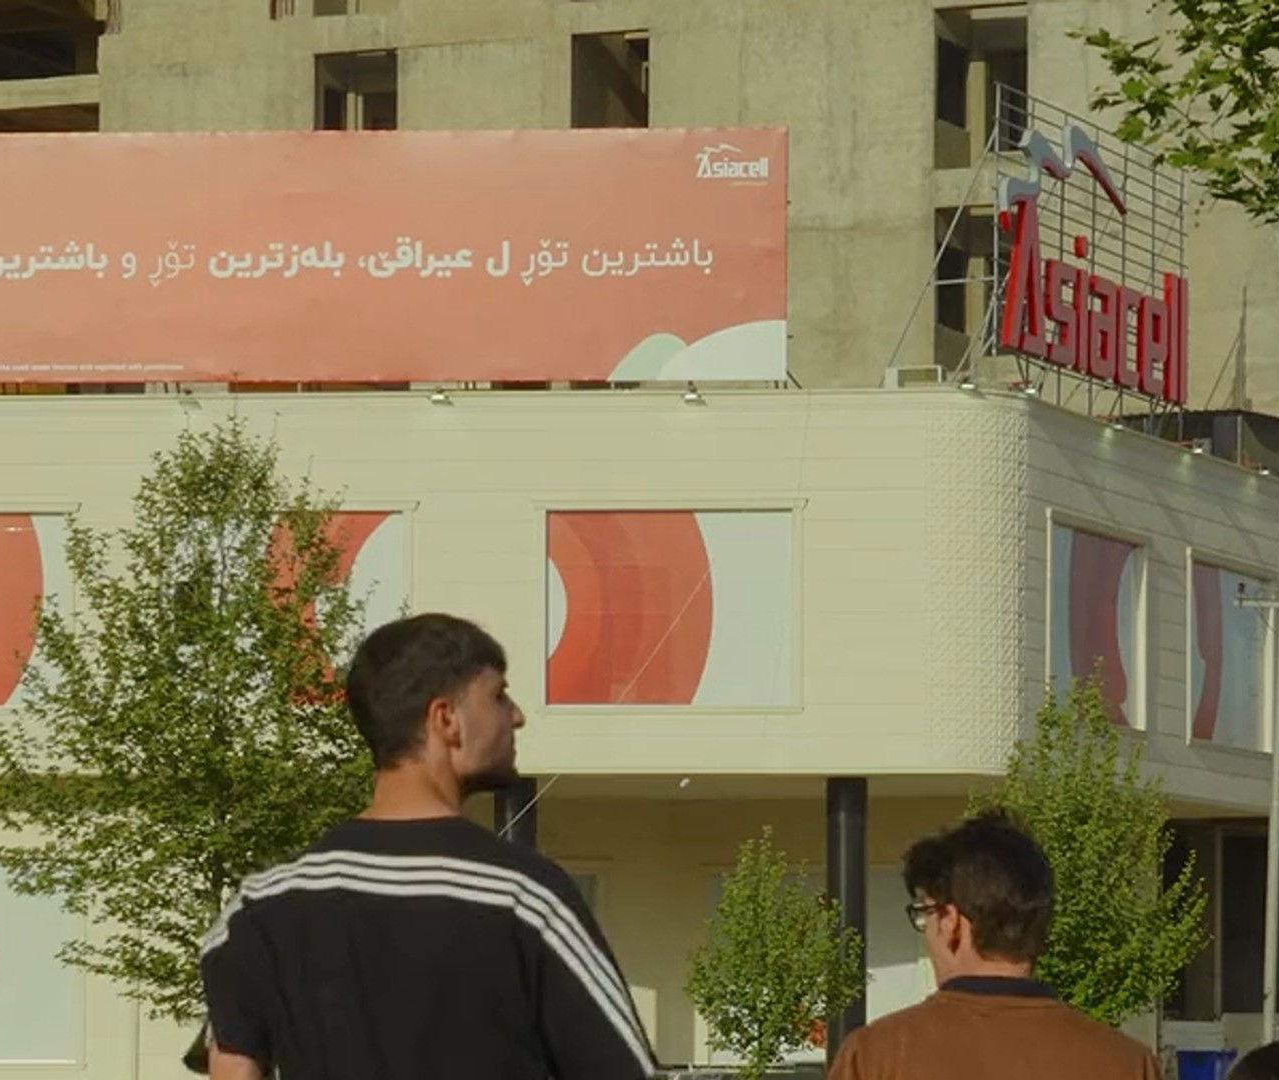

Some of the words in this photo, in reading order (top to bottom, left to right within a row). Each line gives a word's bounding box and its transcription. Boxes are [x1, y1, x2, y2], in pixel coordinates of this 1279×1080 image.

[695, 149, 769, 178] Asiacell
[121, 252, 137, 279] و
[148, 241, 196, 287] تۆڕ
[208, 241, 345, 278] بلەزترین
[486, 240, 510, 276] ل
[521, 238, 569, 286] تۆڕ
[581, 237, 713, 276] باشترین
[999, 197, 1188, 405] Asiacell
